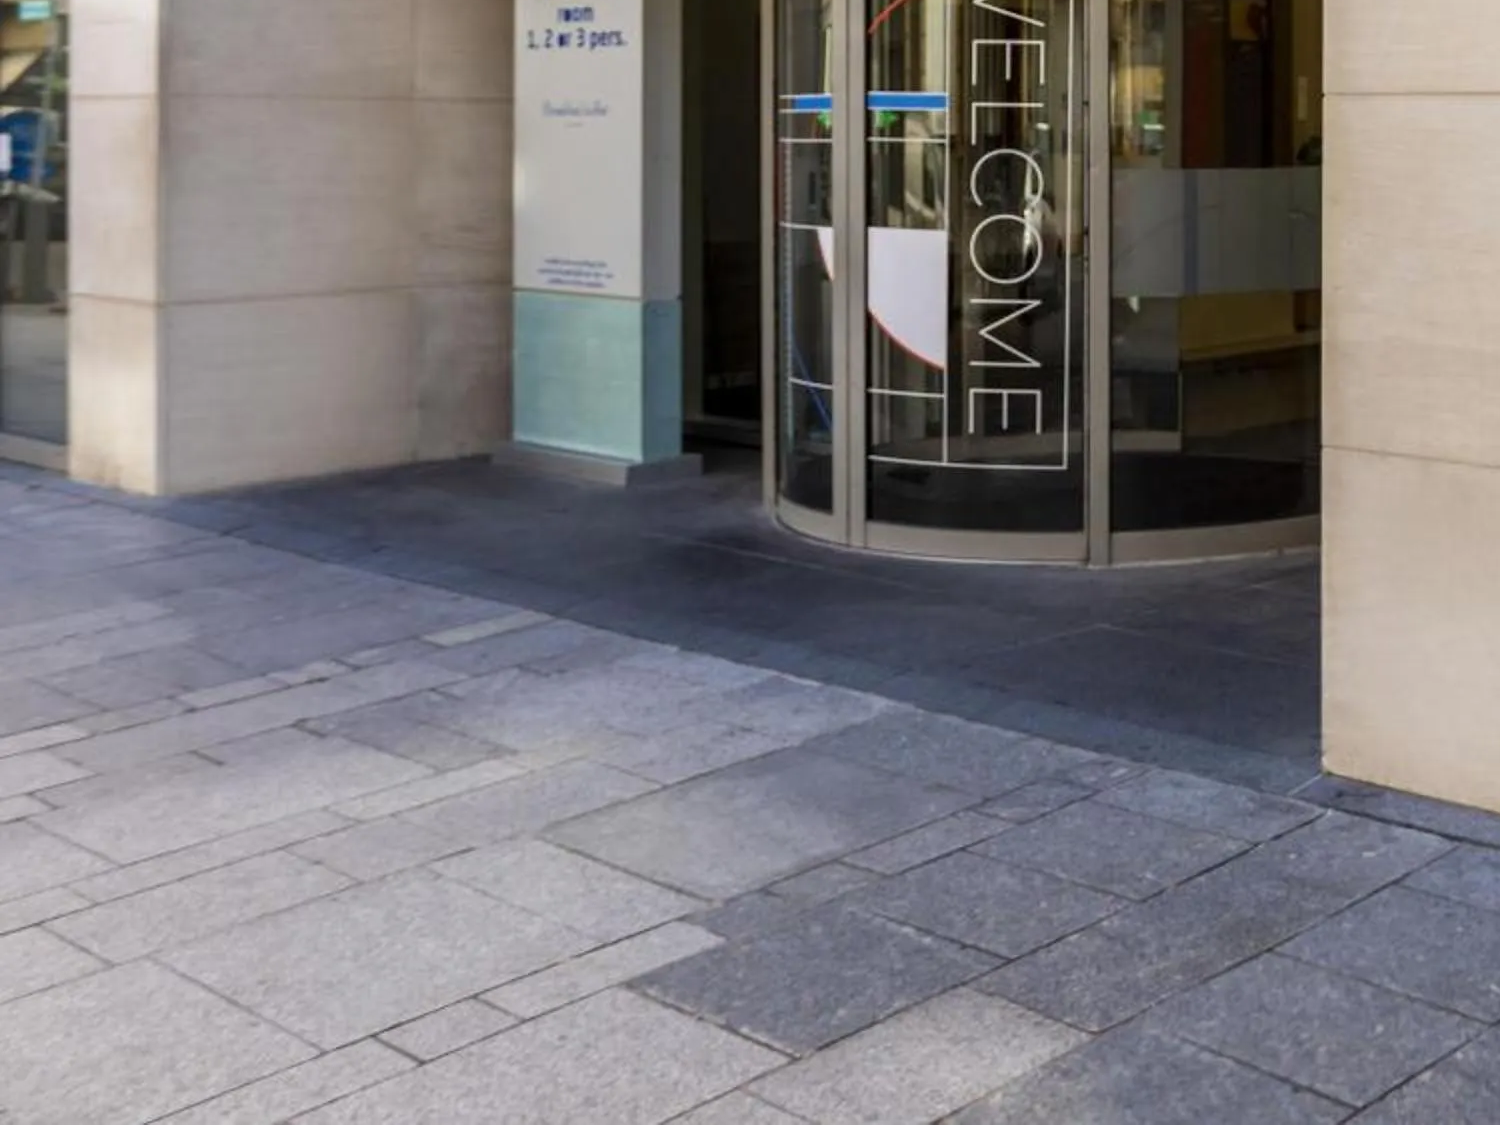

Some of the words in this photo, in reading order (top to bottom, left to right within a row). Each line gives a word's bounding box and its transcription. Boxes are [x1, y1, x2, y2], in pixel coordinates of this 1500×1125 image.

[557, 6, 594, 23] room
[544, 29, 554, 49] 2
[576, 27, 585, 48] 3
